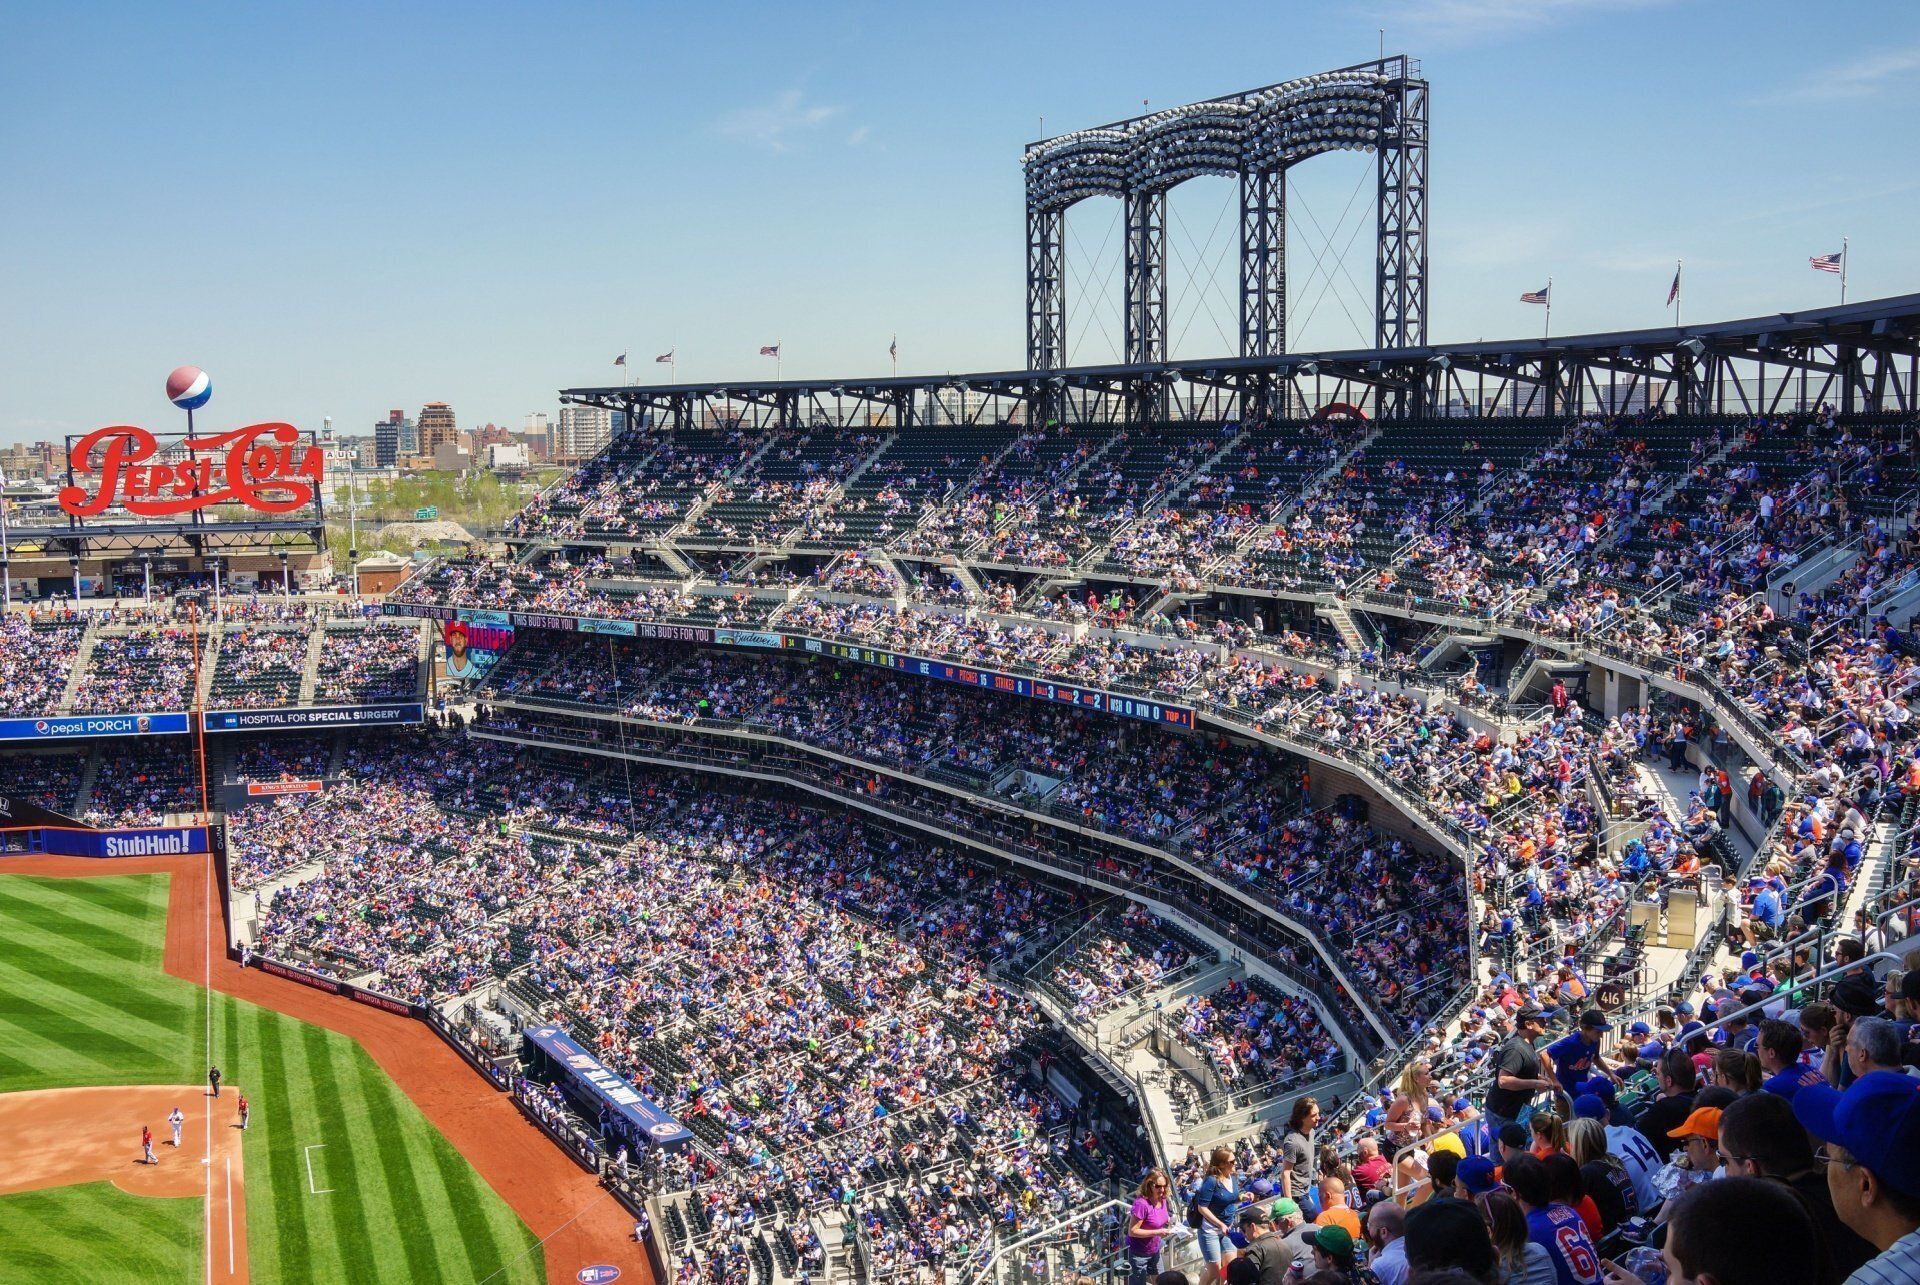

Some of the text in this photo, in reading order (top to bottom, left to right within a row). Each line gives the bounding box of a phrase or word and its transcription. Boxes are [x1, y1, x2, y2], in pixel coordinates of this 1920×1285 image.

[385, 605, 395, 614] 1:17
[400, 605, 453, 620] THIS BUD'S FOR YOU
[513, 614, 573, 630] THIS BUD'S FOR YOU
[641, 624, 709, 642] THIS BUD'S FOR YOU
[788, 639, 795, 647] 34
[805, 639, 823, 653] HARPER
[870, 652, 874, 664] 5
[888, 655, 895, 667] 15
[920, 662, 929, 675] GEE
[959, 669, 978, 683] PITCHES
[994, 676, 1015, 691] STRIKES
[1017, 681, 1023, 693] 8
[1036, 686, 1048, 696] BALLS
[1048, 685, 1054, 699] 3
[1057, 689, 1073, 701] STRIKES
[1072, 690, 1079, 704] 2
[1094, 694, 1100, 709] 2
[240, 709, 400, 725] HOSPITAL FOR SPECIAL SURGERY
[1110, 697, 1187, 724] WSH 0 NYM 0 TOP 1
[51, 722, 84, 735] pepsi
[88, 720, 132, 731] PORCH
[106, 830, 190, 857] StubHub!
[269, 963, 286, 975] TOYOTA
[294, 972, 312, 984] TOYOTA
[320, 980, 338, 992] TOYOTA
[362, 993, 380, 1005] TOYOTA
[1601, 992, 1620, 1005] 416
[390, 1002, 409, 1014] TOYOTA
[1622, 1135, 1659, 1172] 14
